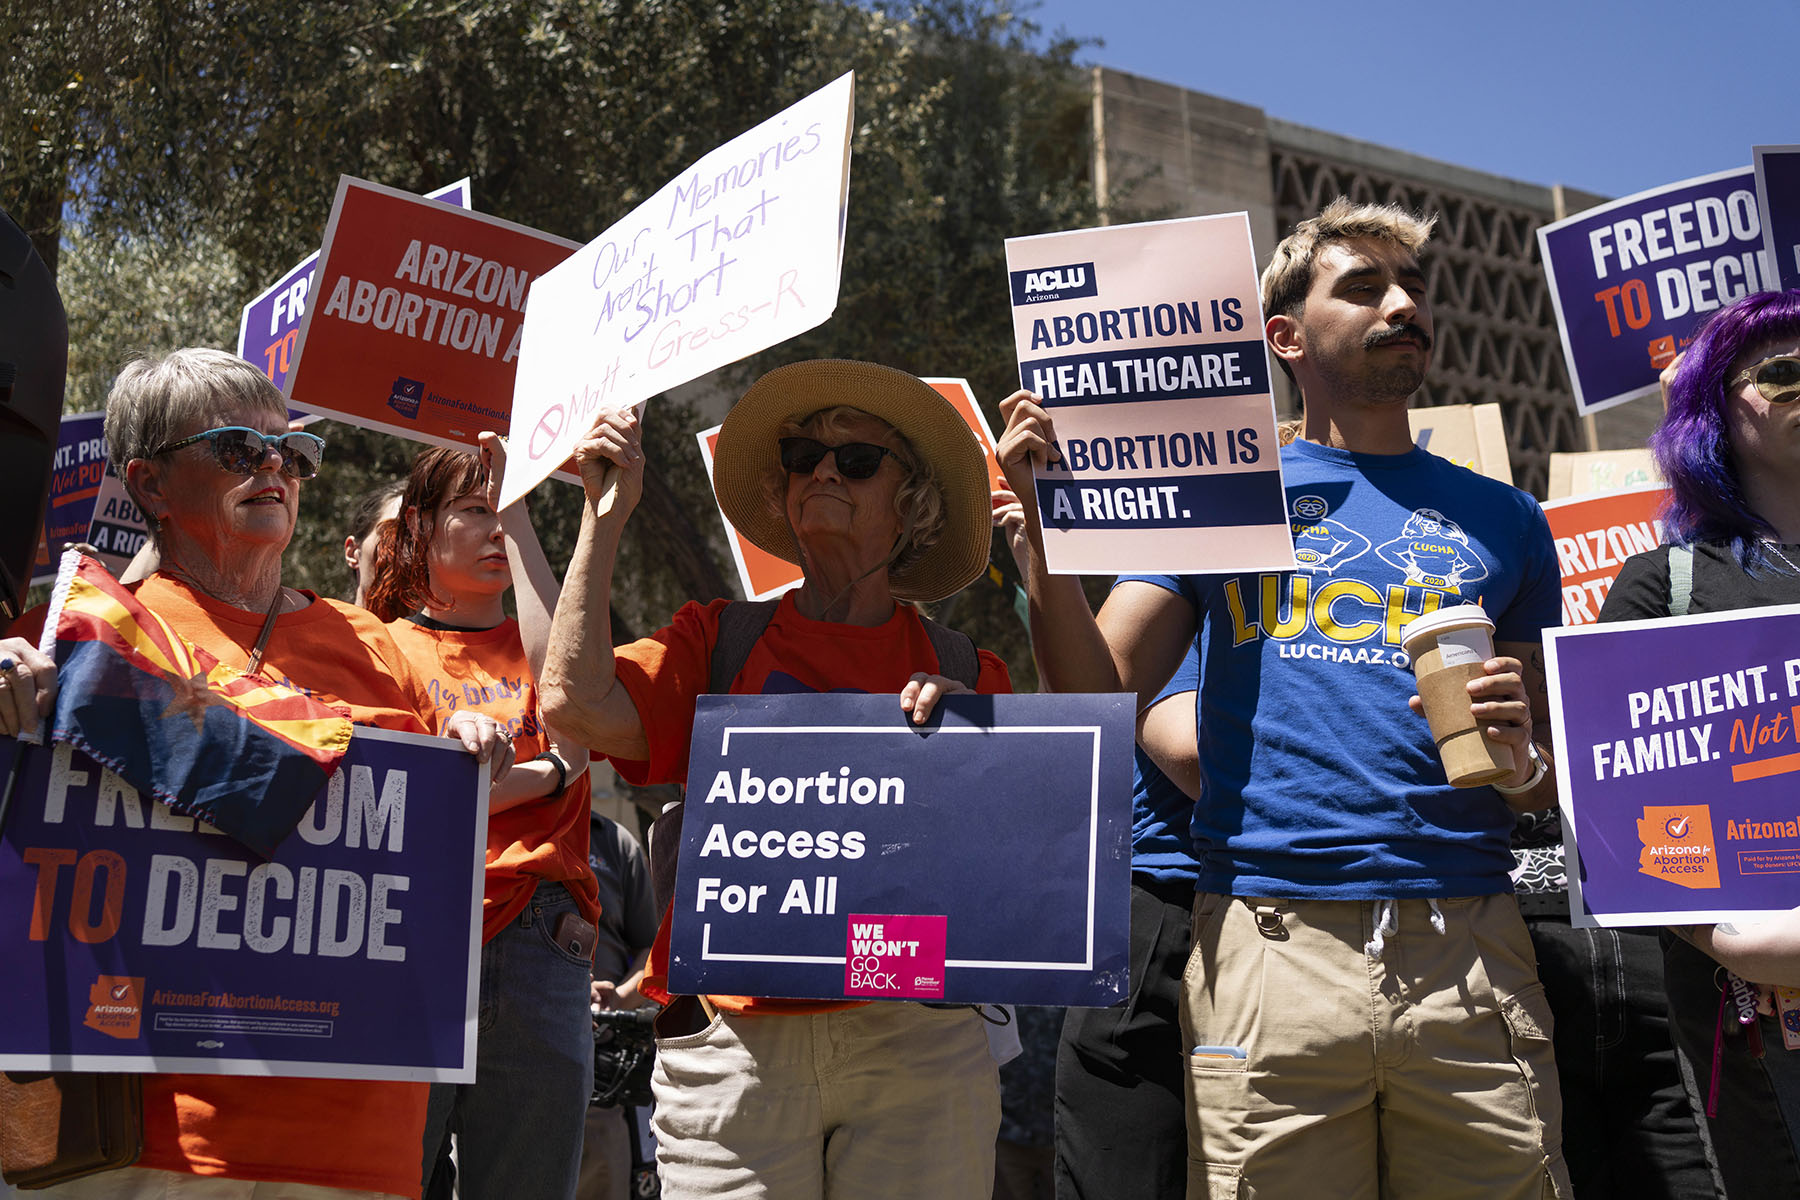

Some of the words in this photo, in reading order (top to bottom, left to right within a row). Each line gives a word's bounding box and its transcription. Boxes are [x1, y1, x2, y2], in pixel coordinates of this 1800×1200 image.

[593, 227, 651, 290] Our
[667, 120, 821, 230] Memories
[1589, 190, 1761, 279] FREEDO
[394, 239, 530, 313] ARIZON
[594, 252, 658, 335] Aren't
[675, 189, 779, 262] That
[1025, 267, 1085, 293] ACLU
[624, 252, 737, 343] Short
[1025, 293, 1060, 303] Arizona
[1594, 279, 1651, 338] TO
[324, 275, 504, 358] ABORTION
[1031, 301, 1202, 350] ABORTION
[1210, 298, 1244, 332] IS
[1032, 352, 1251, 400] HEALTHCARE.
[564, 355, 621, 437] Matt
[1227, 428, 1260, 465] IS
[52, 470, 77, 495] Not
[1052, 488, 1076, 520] A
[1080, 486, 1191, 520] RIGHT.
[94, 526, 109, 549] A
[1414, 541, 1455, 556] LUCHA
[1554, 520, 1668, 578] RIZON
[1297, 553, 1317, 561] 2020
[1424, 576, 1445, 587] 2020
[1224, 573, 1470, 648] LUCH
[1280, 643, 1411, 669] LUCHAAZ.O
[1628, 665, 1778, 729] PATIENT.
[1593, 723, 1720, 781] FAMILY.
[1729, 712, 1789, 754] Not
[704, 766, 905, 805] Abortion
[699, 823, 866, 859] Access
[1650, 844, 1700, 855] Arizona
[1653, 854, 1710, 865] Abortion
[1660, 865, 1705, 874] Access
[23, 847, 127, 944] TO
[141, 854, 410, 962] DECIDE
[696, 878, 767, 914] For
[779, 876, 838, 914] All
[851, 939, 920, 957] WON'T
[852, 923, 884, 940] WE
[850, 972, 901, 990] BACK.
[851, 956, 880, 973] GO
[152, 989, 340, 1017] ArizonaForAbortionAccess.org
